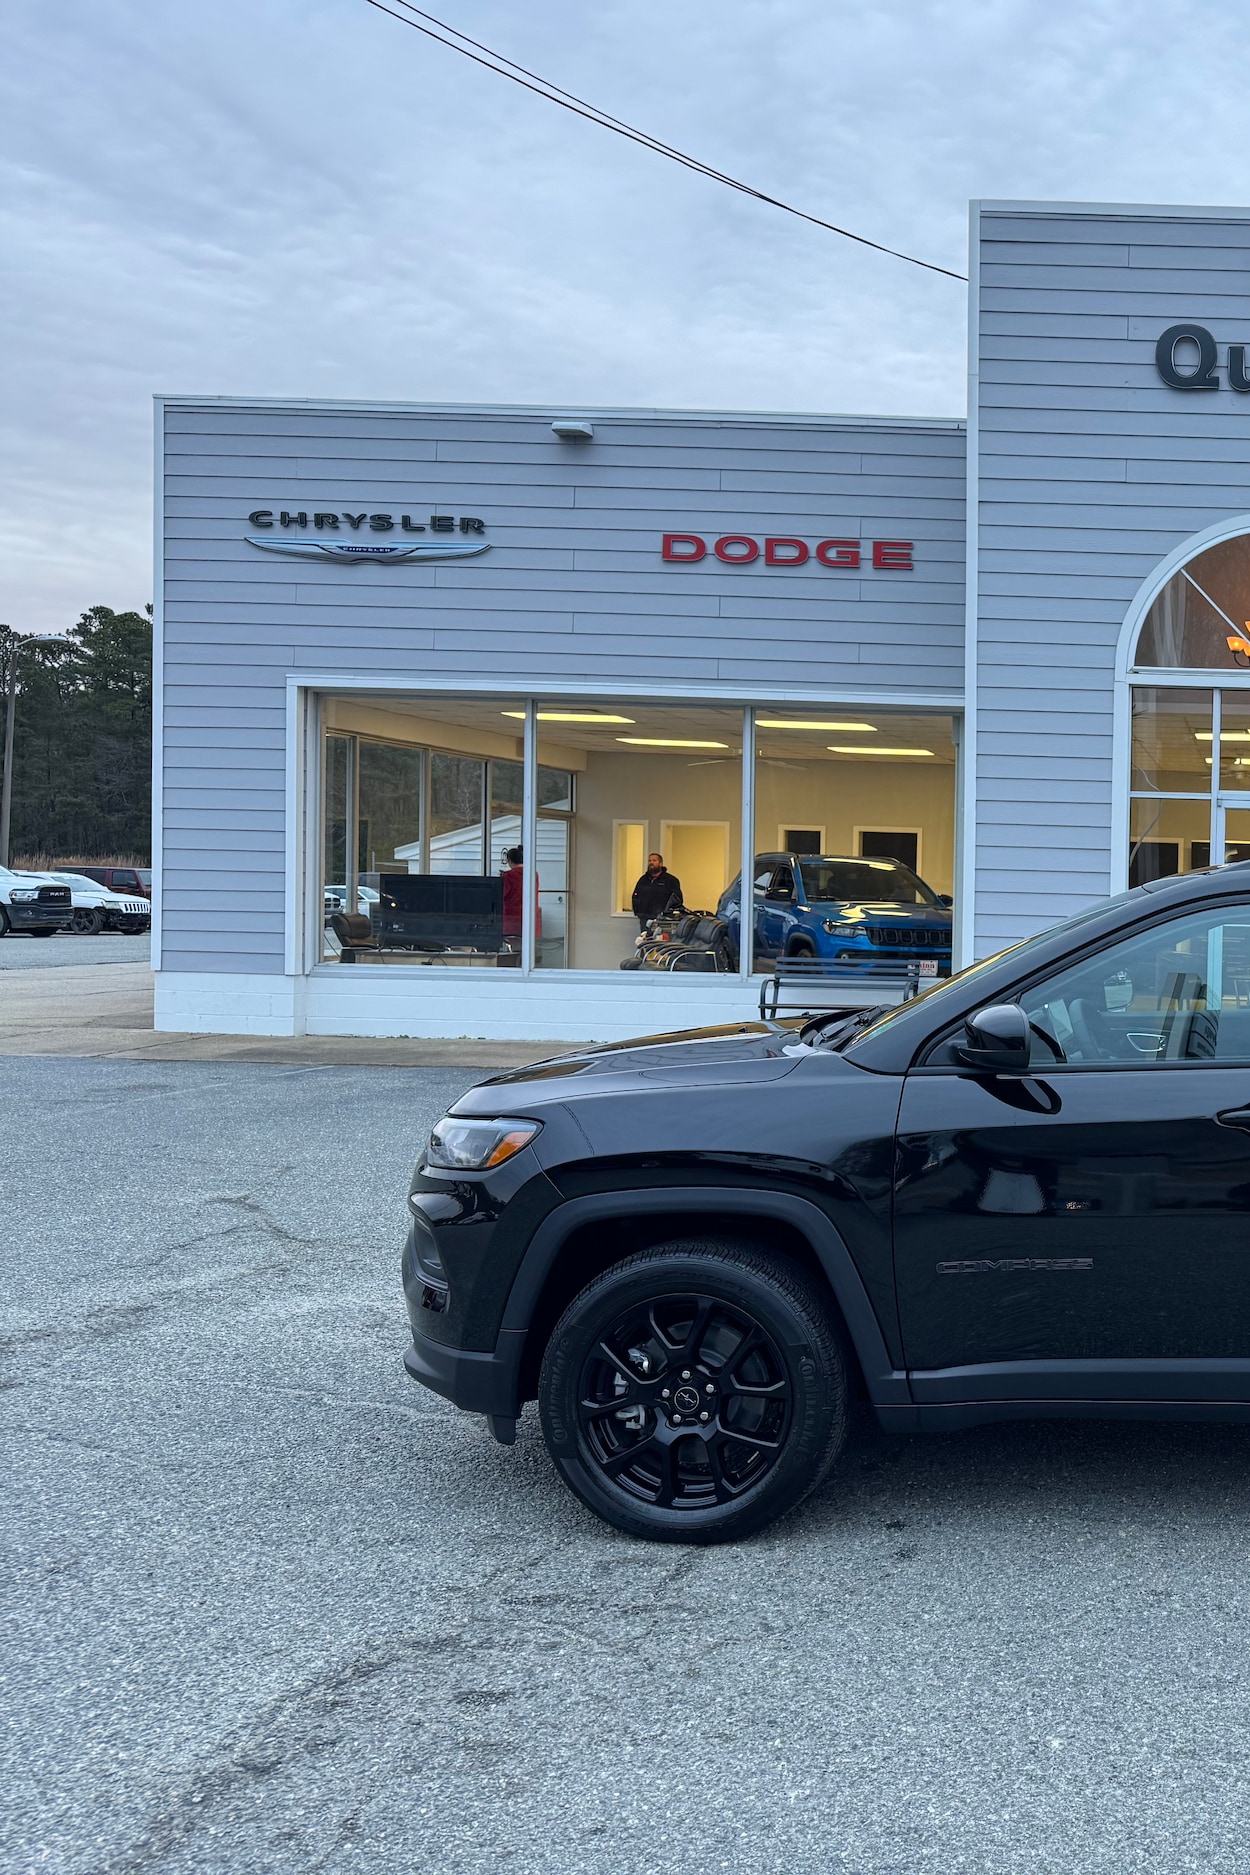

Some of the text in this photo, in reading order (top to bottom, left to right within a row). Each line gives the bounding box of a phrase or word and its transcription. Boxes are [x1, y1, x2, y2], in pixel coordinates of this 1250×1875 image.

[247, 510, 486, 534] CHRYSLER
[661, 533, 914, 570] DODGE
[936, 1258, 1094, 1274] COMPASS
